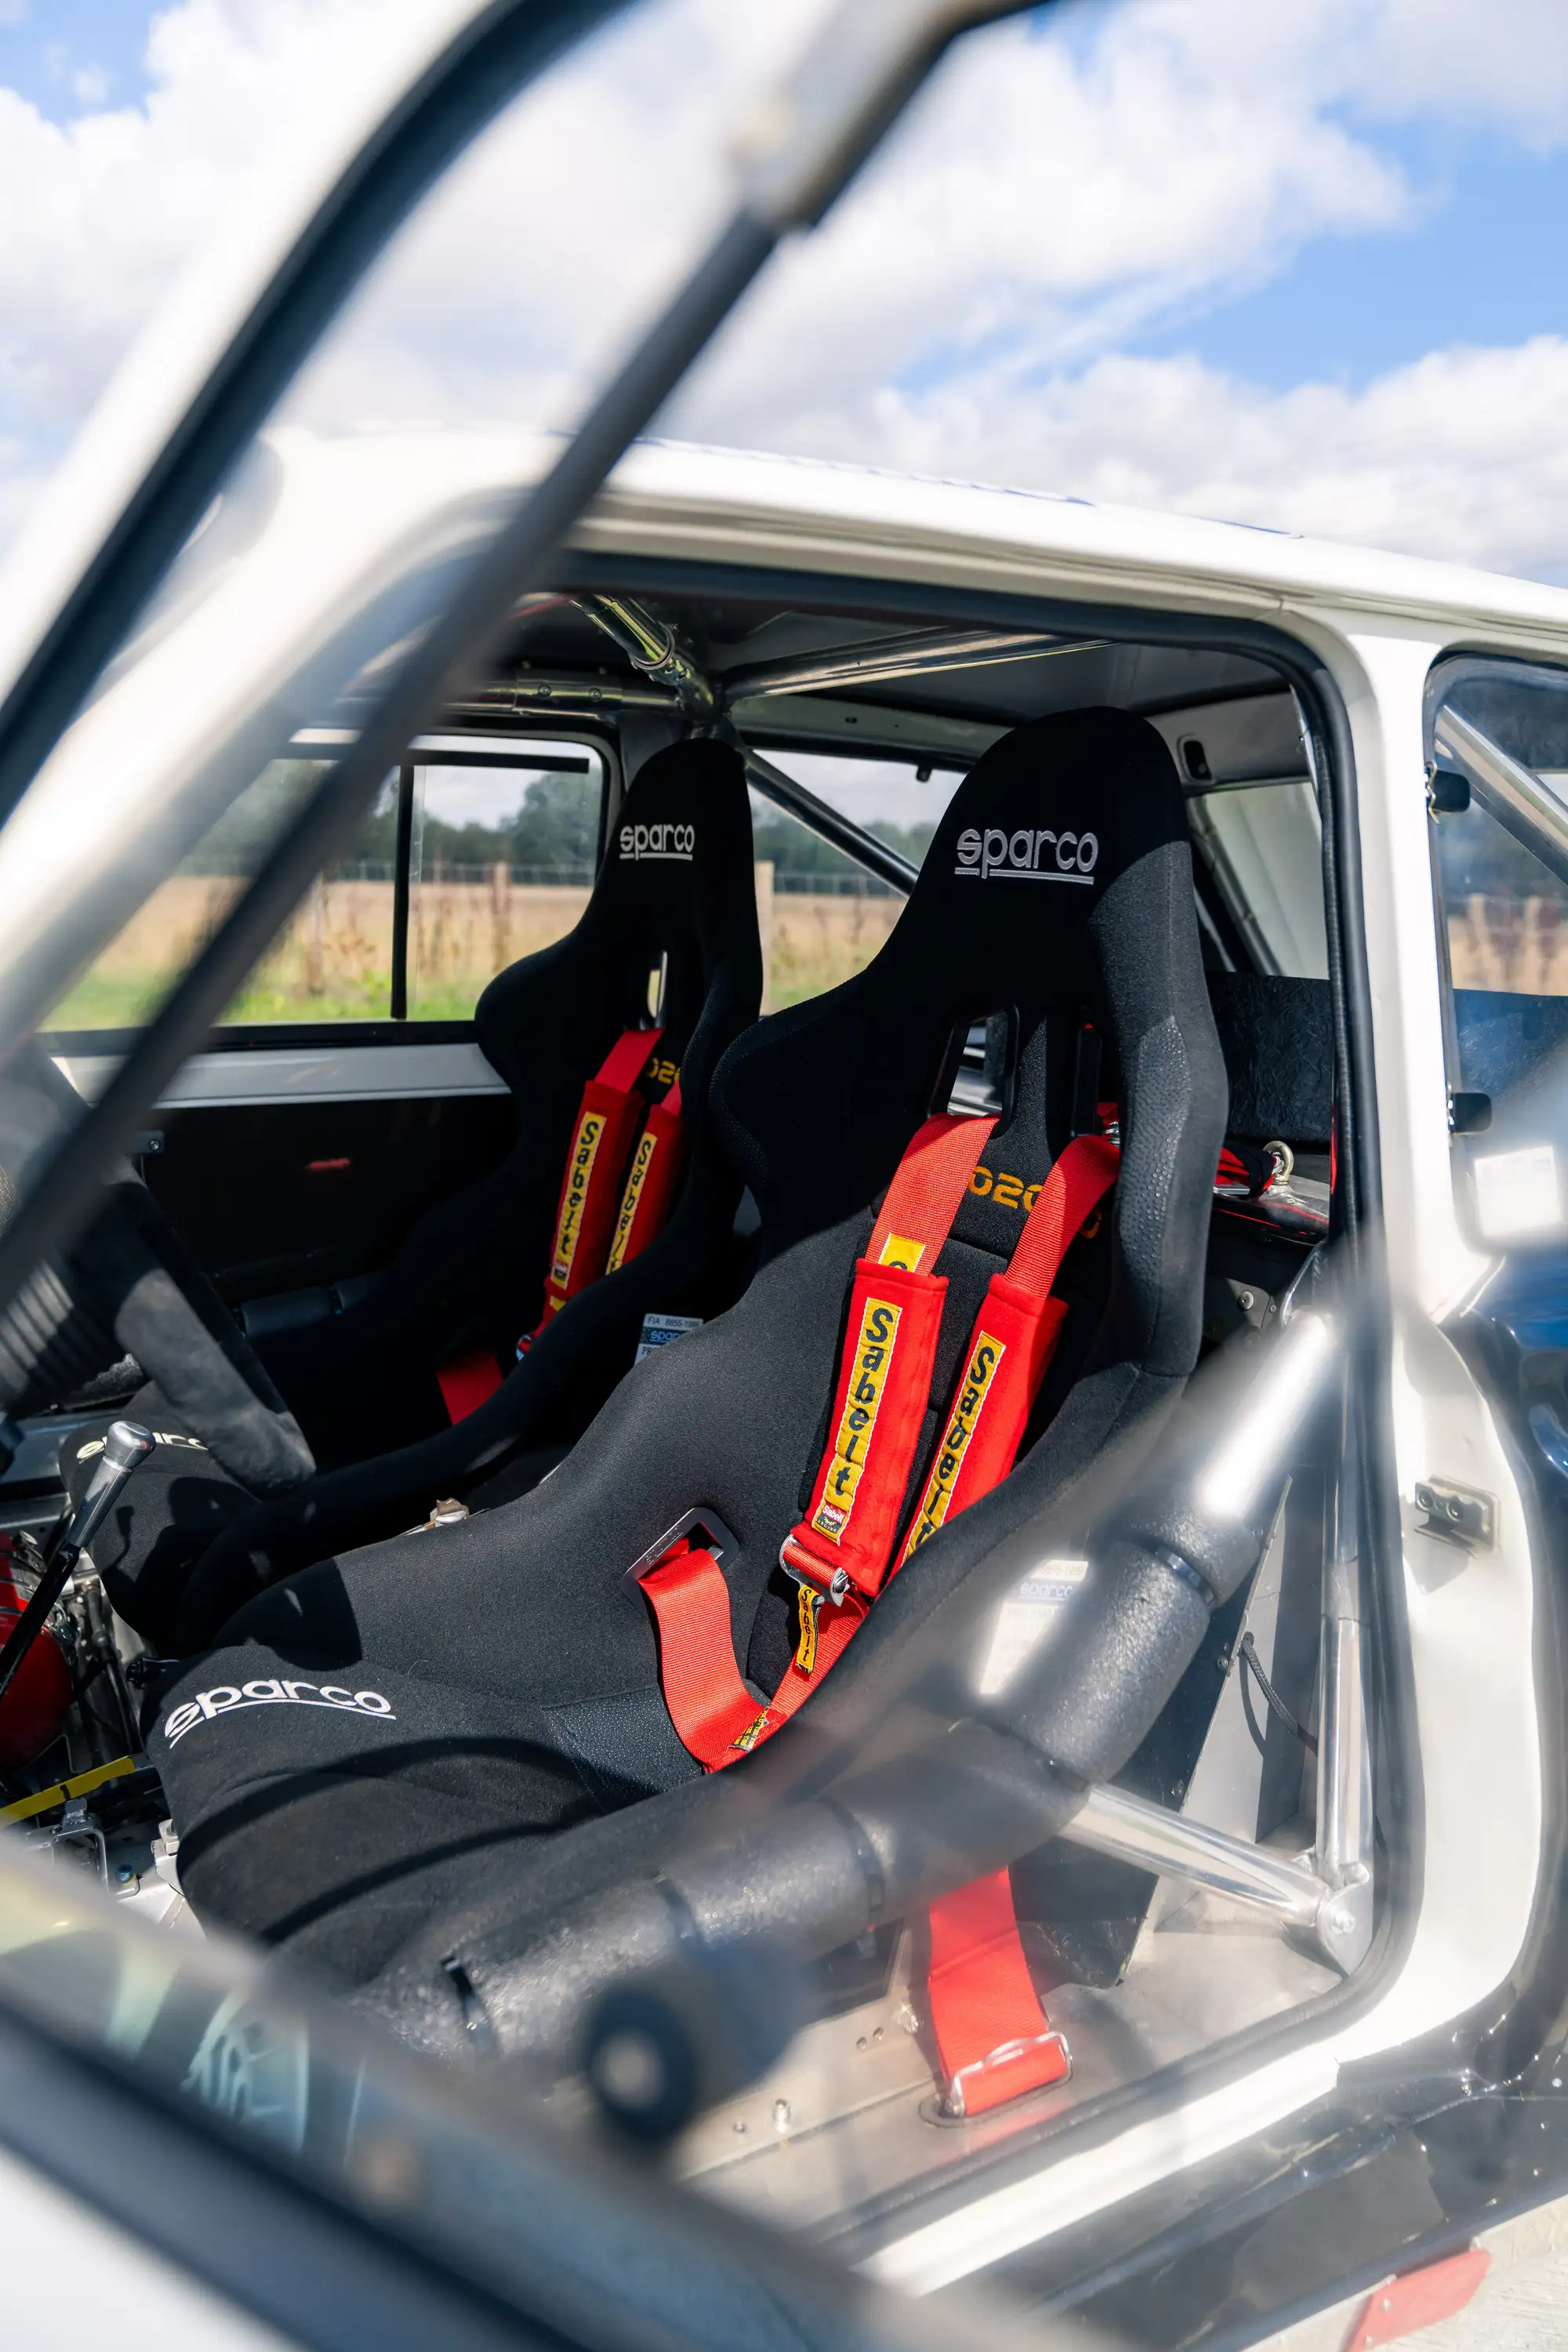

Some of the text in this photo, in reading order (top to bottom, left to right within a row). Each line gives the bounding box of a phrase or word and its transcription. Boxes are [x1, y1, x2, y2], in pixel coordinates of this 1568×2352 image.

[619, 825, 695, 861] sparco
[956, 828, 1098, 880] sparco
[561, 1120, 599, 1255] Sabelt
[648, 1316, 660, 1325] FIA
[835, 1308, 894, 1496] Sabelt
[822, 1504, 845, 1523] Sabelt
[800, 1588, 812, 1663] Sabelt
[164, 1679, 393, 1740] sparco
